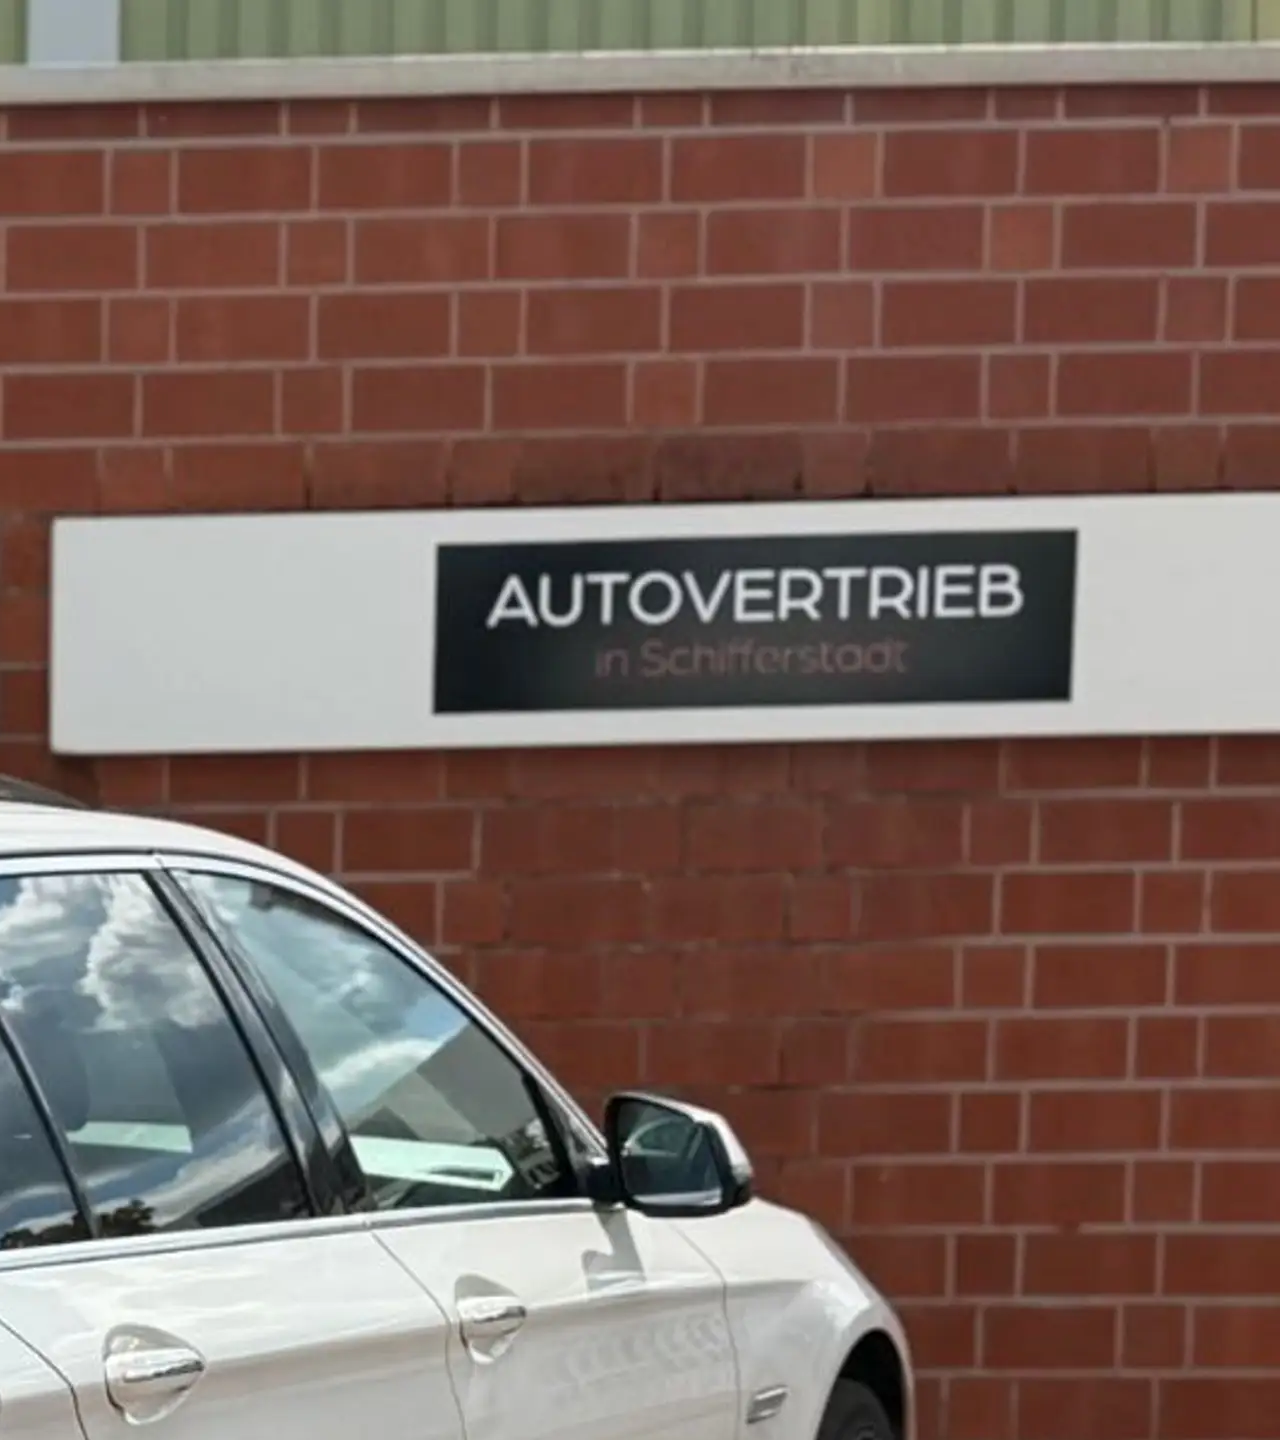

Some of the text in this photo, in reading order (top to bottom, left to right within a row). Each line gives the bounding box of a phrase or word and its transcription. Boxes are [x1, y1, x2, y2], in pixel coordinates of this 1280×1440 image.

[486, 563, 1025, 629] AUTOVERTRIEB
[594, 635, 910, 678] in Schifferstadt
